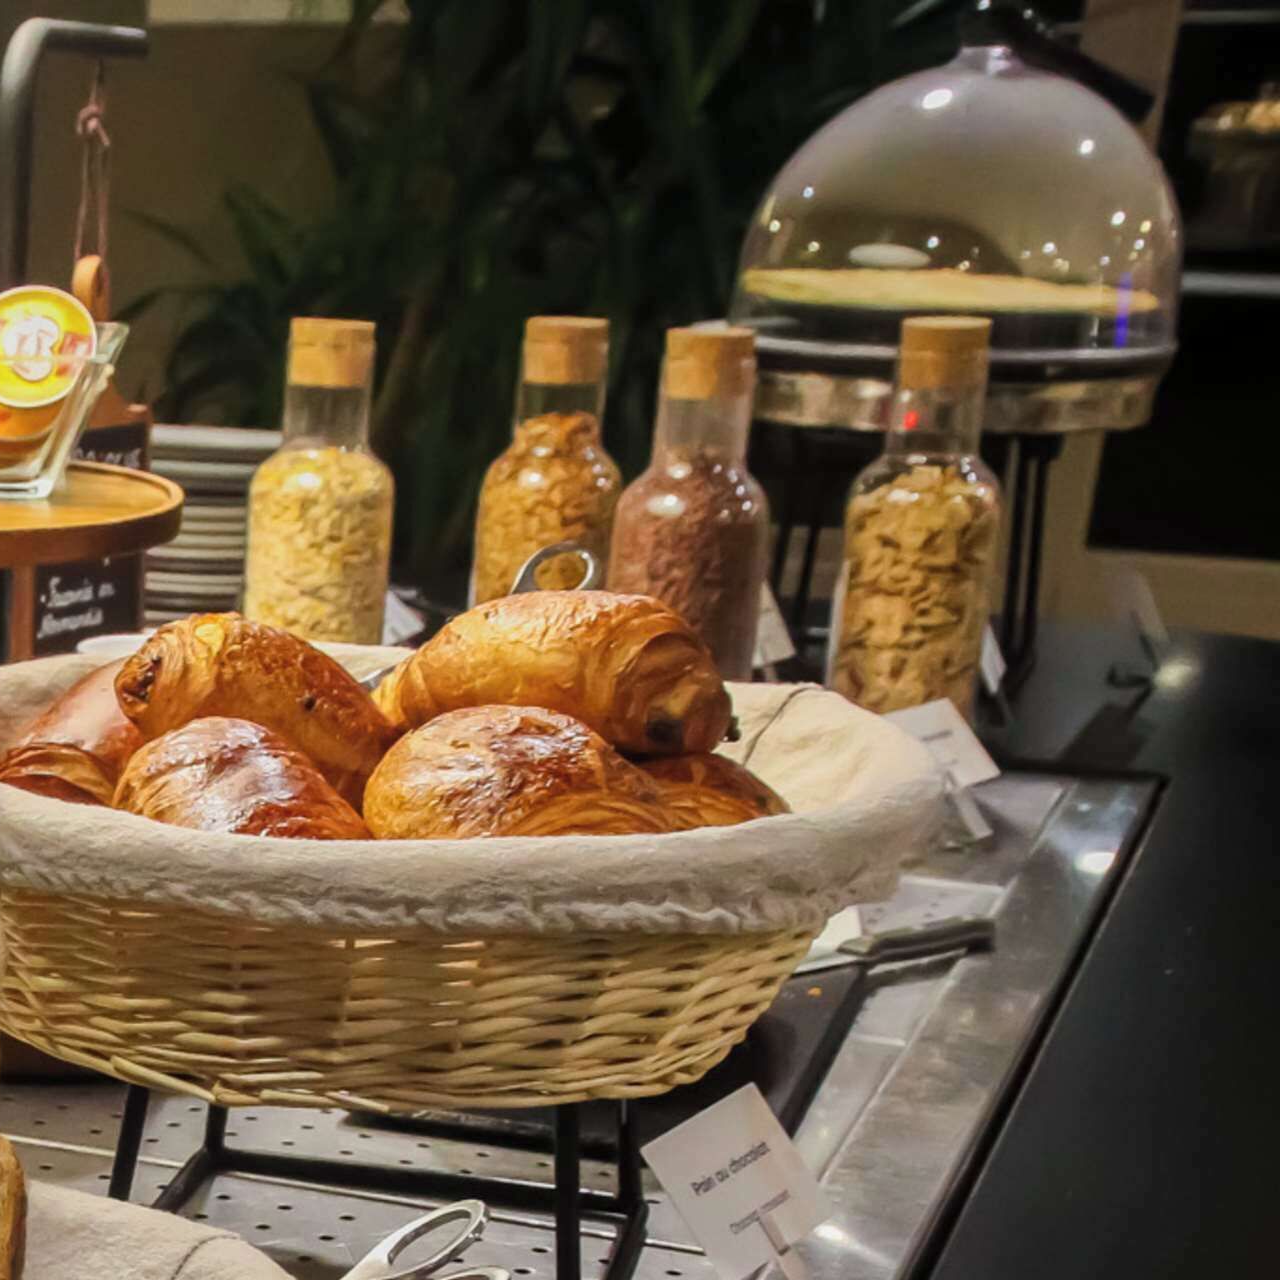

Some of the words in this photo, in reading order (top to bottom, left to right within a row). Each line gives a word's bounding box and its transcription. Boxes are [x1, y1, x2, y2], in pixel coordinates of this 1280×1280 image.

[690, 1177, 717, 1196] Pain
[715, 1167, 730, 1183] au
[728, 1141, 771, 1174] chocolat
